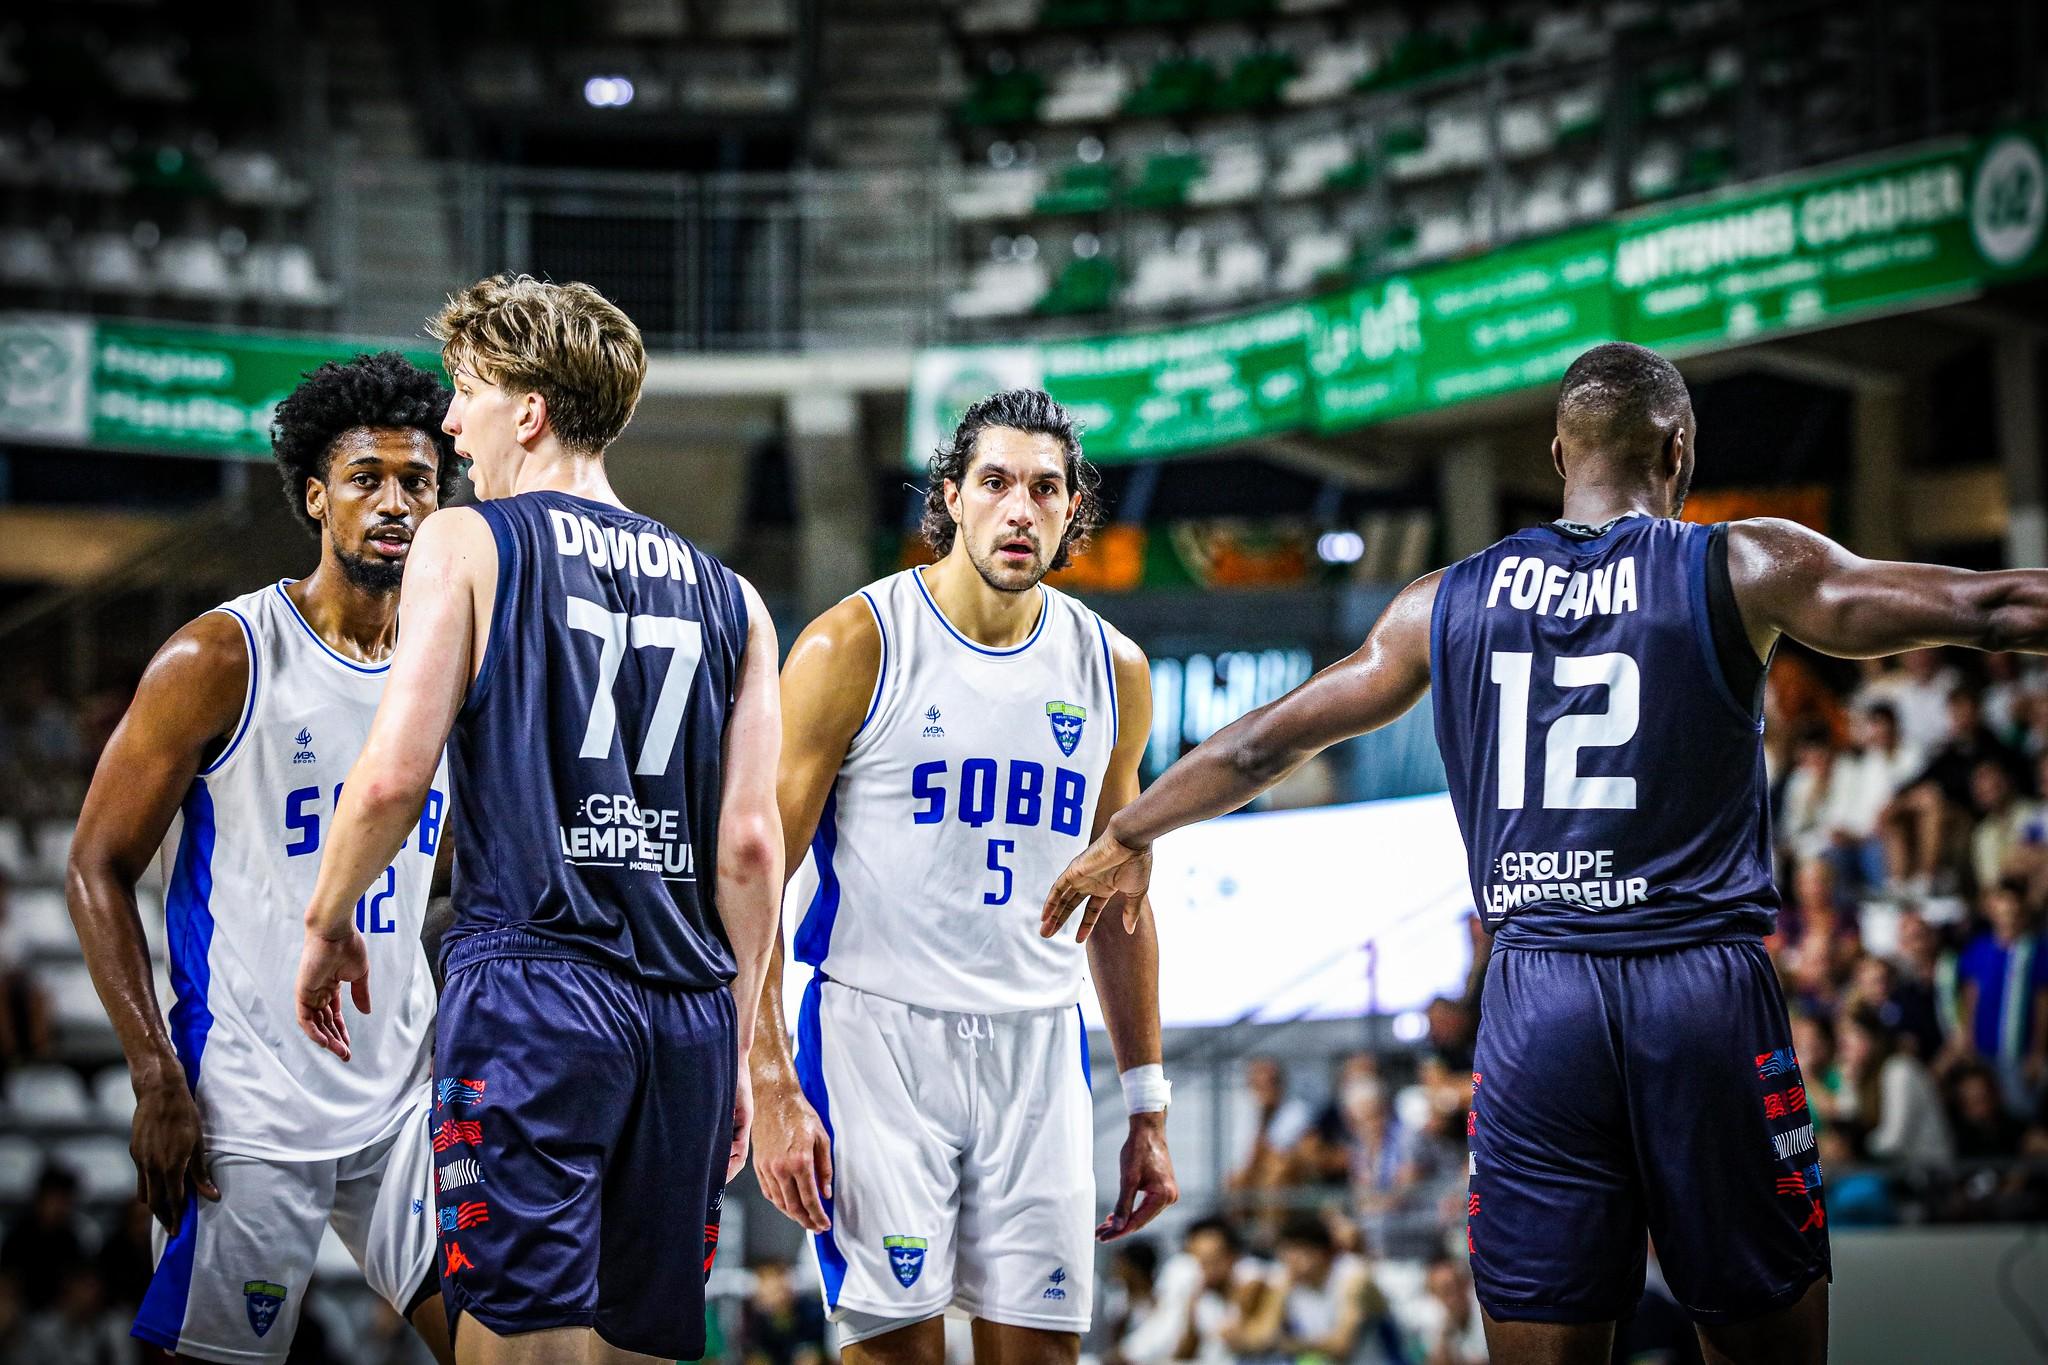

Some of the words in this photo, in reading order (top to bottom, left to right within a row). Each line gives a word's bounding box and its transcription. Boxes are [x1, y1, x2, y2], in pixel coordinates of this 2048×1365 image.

[548, 508, 697, 585] DOMON
[1486, 556, 1638, 620] FOFANA
[566, 595, 702, 776] 77
[1490, 651, 1641, 809] 12
[285, 782, 444, 857] SB
[911, 758, 1087, 837] SQBB
[983, 838, 1015, 905] 5
[1482, 876, 1649, 913] LEMPEREUR
[1500, 850, 1614, 882] GROUPE
